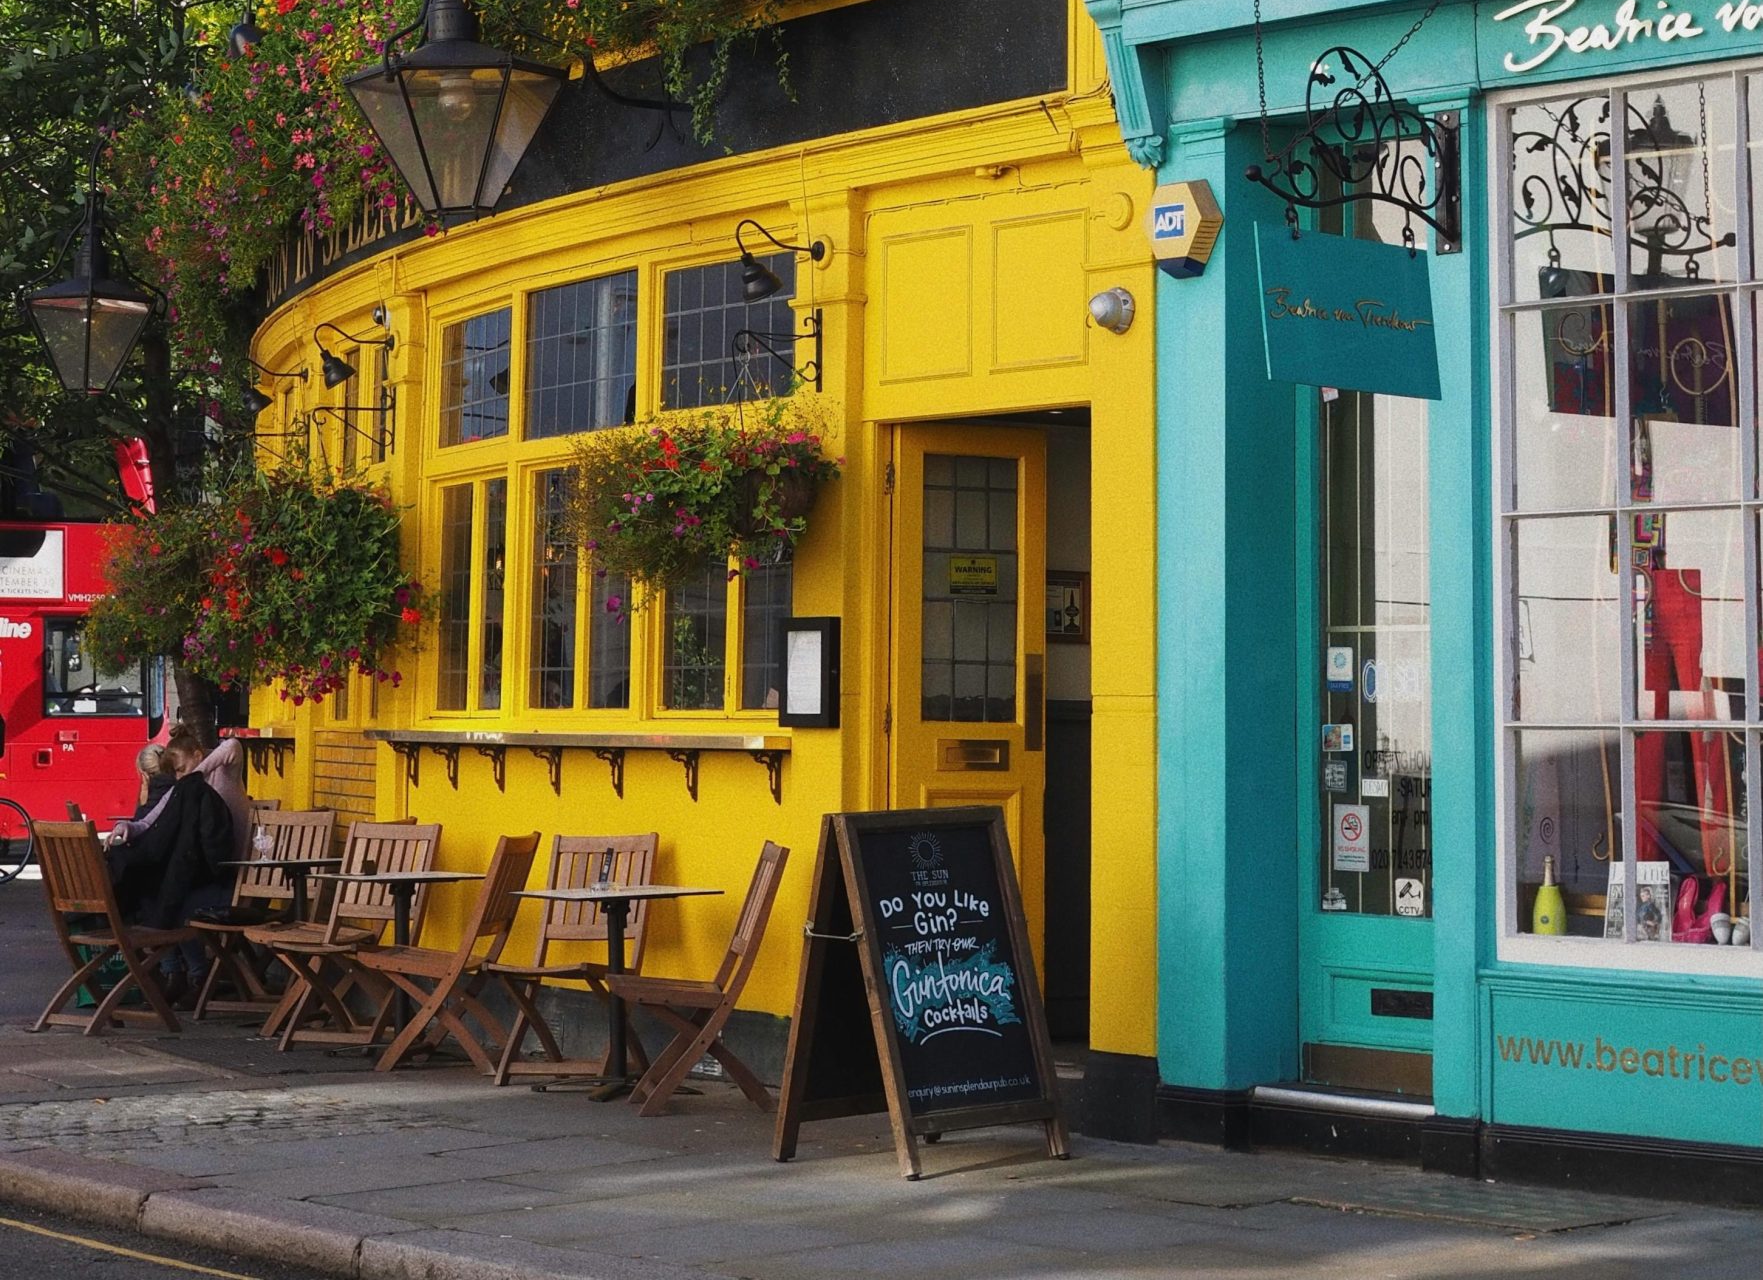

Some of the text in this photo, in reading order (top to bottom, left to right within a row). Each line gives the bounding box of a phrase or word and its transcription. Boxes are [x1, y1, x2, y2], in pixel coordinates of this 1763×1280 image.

[1154, 210, 1185, 233] ADT
[954, 566, 992, 574] WARNING
[62, 743, 75, 753] PA
[909, 869, 949, 881] THE SUN
[911, 891, 946, 909] YOU
[1398, 905, 1420, 914] CCTV
[914, 908, 957, 935] Gin?
[904, 940, 932, 955] THEN
[932, 938, 950, 958] TRY
